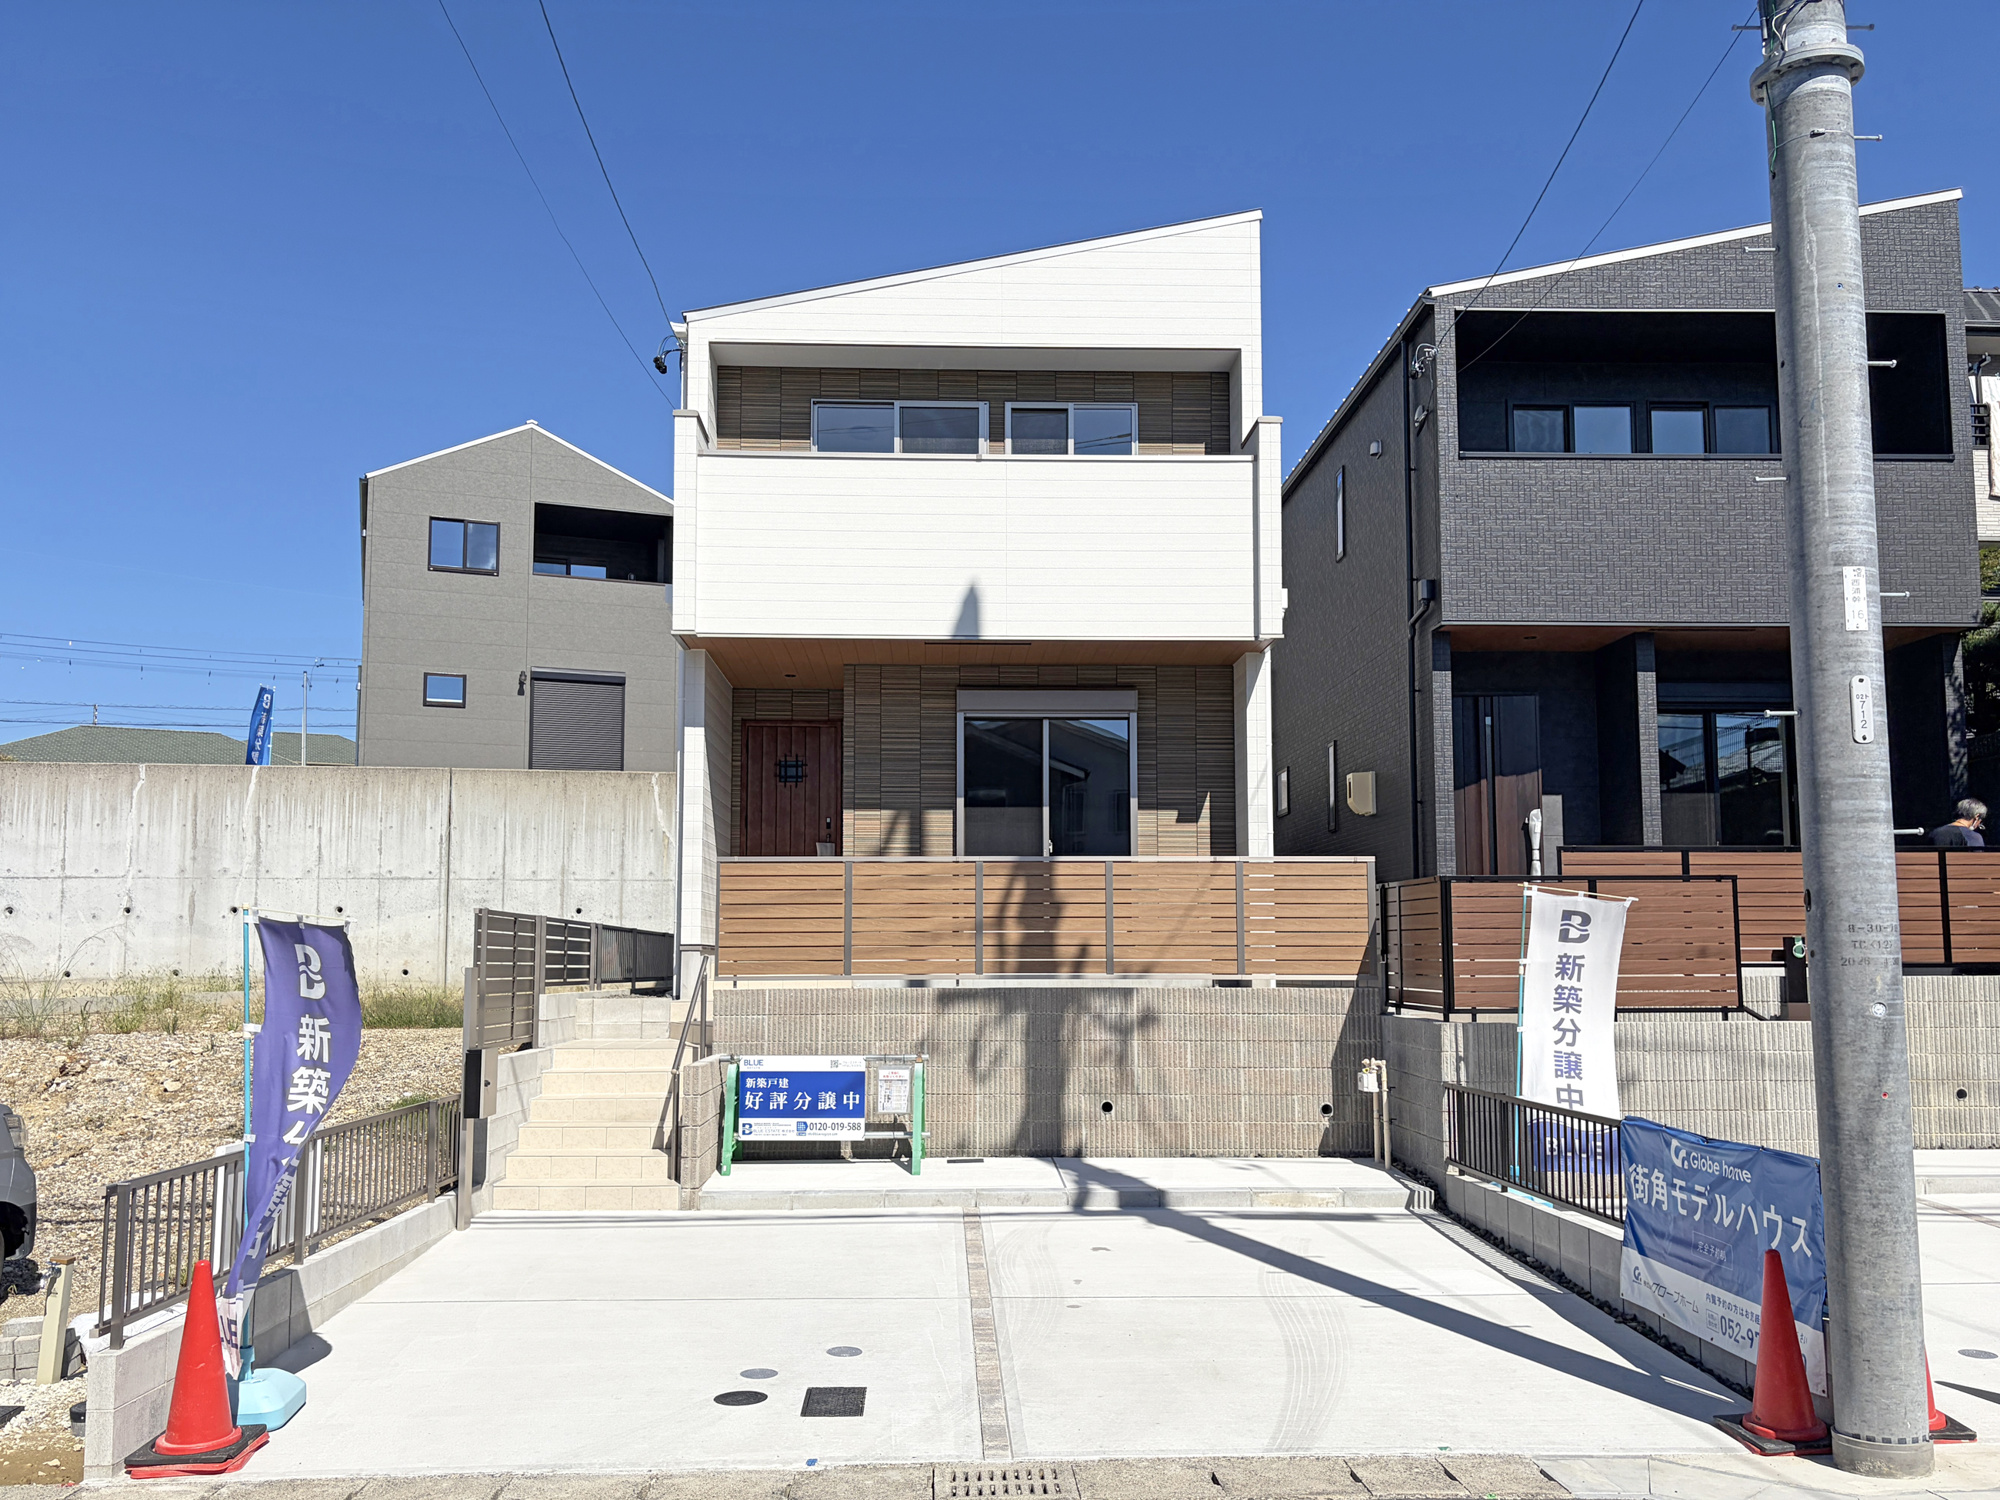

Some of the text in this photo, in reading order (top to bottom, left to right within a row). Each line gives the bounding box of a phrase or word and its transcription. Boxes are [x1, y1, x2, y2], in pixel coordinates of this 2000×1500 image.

[1851, 609, 1865, 620] 16
[1859, 700, 1867, 729] 712
[1552, 952, 1586, 1110] 新築分譲中
[743, 1059, 764, 1067] BLUE
[745, 1077, 790, 1089] 新築戸建
[745, 1091, 860, 1111] 好評分譲中
[809, 1122, 862, 1131] 0120-019-588
[1689, 1151, 1752, 1183] Globe home
[1628, 1163, 1812, 1258] 街角モデルハウス
